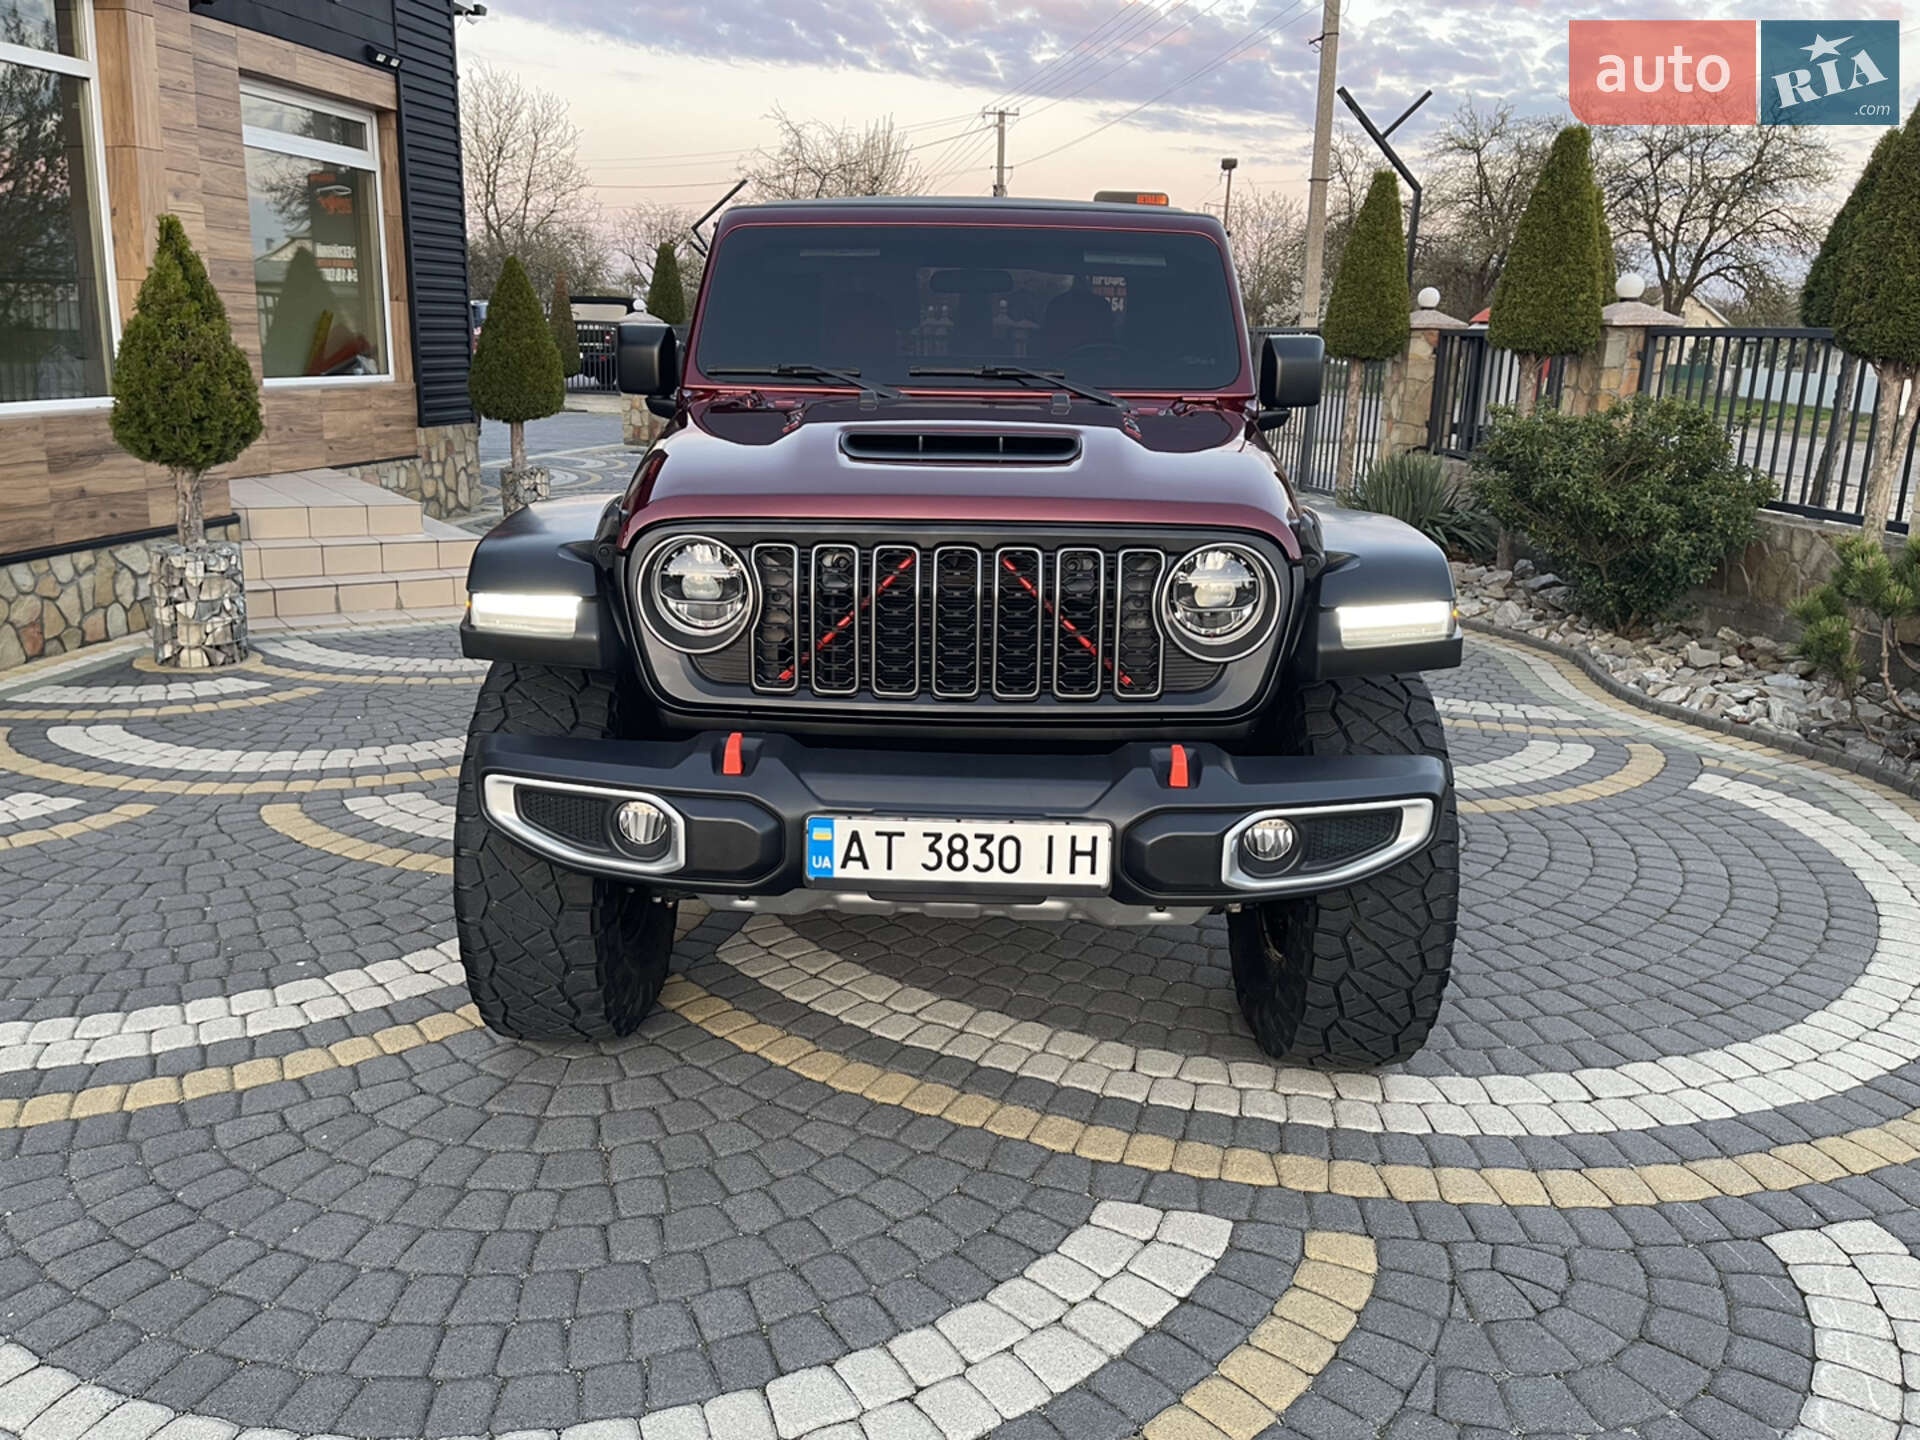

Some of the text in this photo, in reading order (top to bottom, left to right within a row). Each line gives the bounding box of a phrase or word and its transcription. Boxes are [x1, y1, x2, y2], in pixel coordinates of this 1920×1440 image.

[812, 856, 832, 868] UA
[840, 830, 1099, 875] AT 3830 IH
